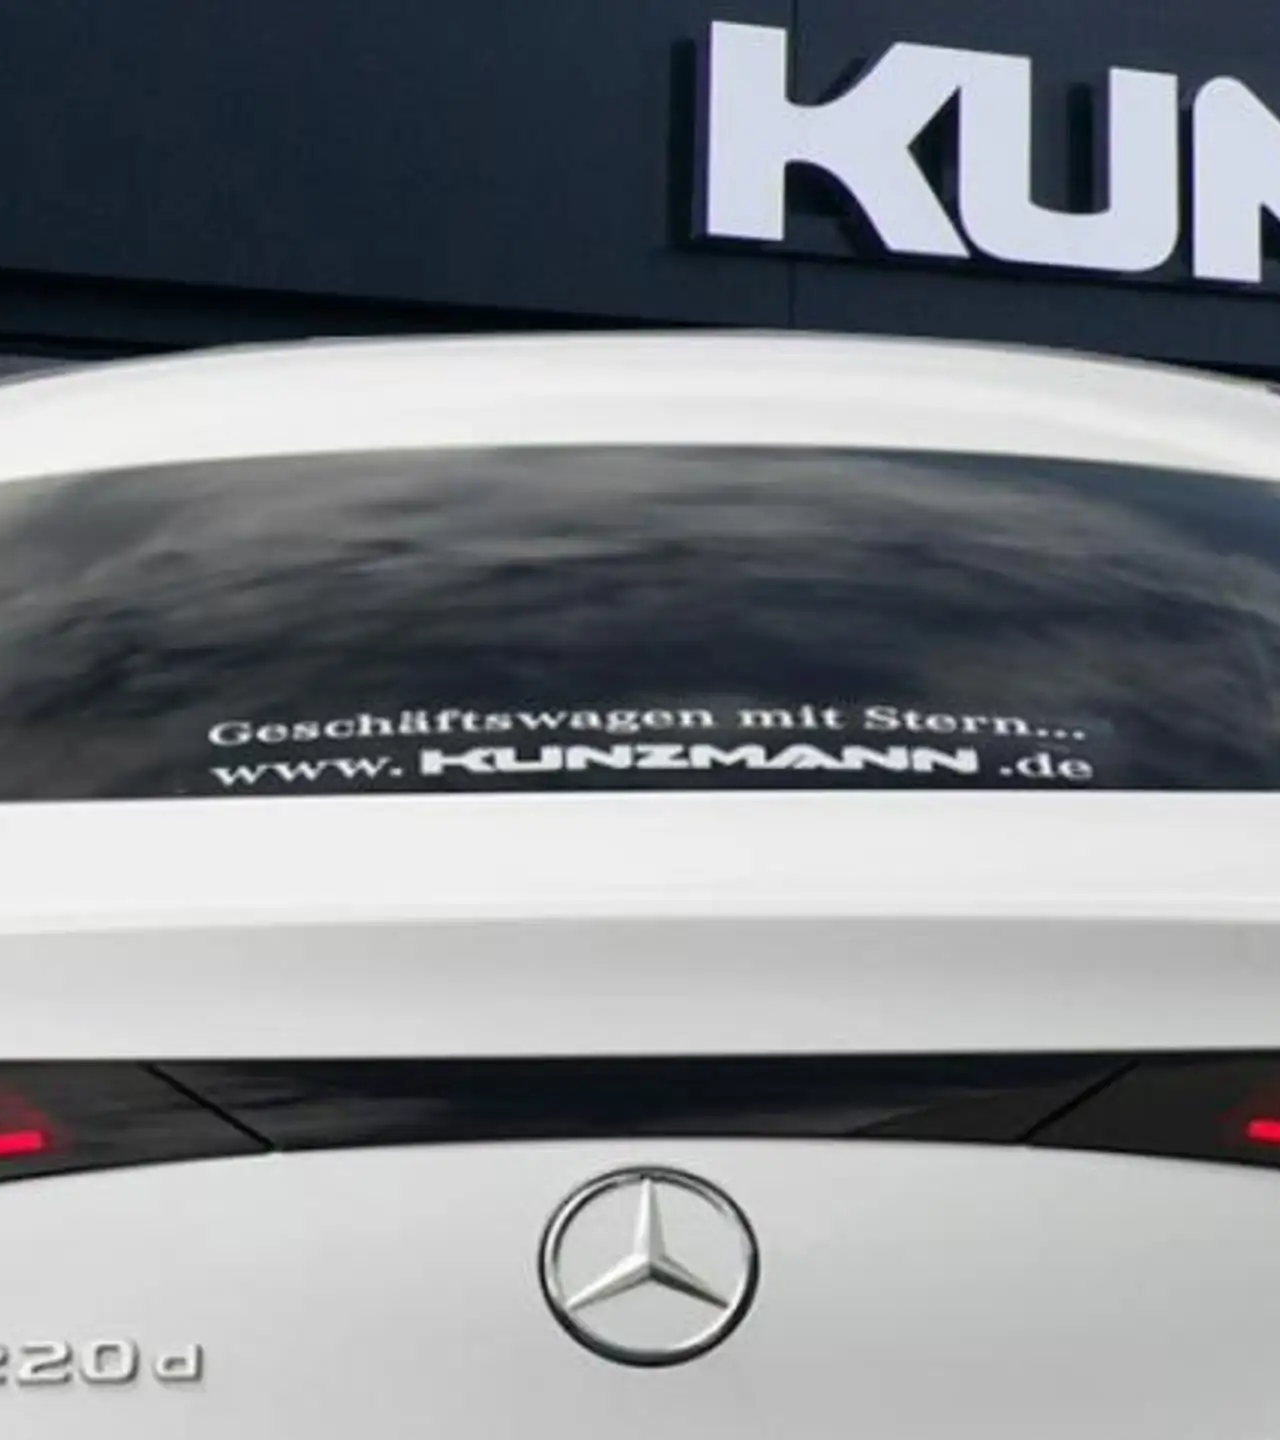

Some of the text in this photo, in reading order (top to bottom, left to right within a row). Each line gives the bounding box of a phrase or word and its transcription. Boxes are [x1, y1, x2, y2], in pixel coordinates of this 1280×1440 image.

[208, 704, 1086, 746] Geschäftswagen mit Stern...
